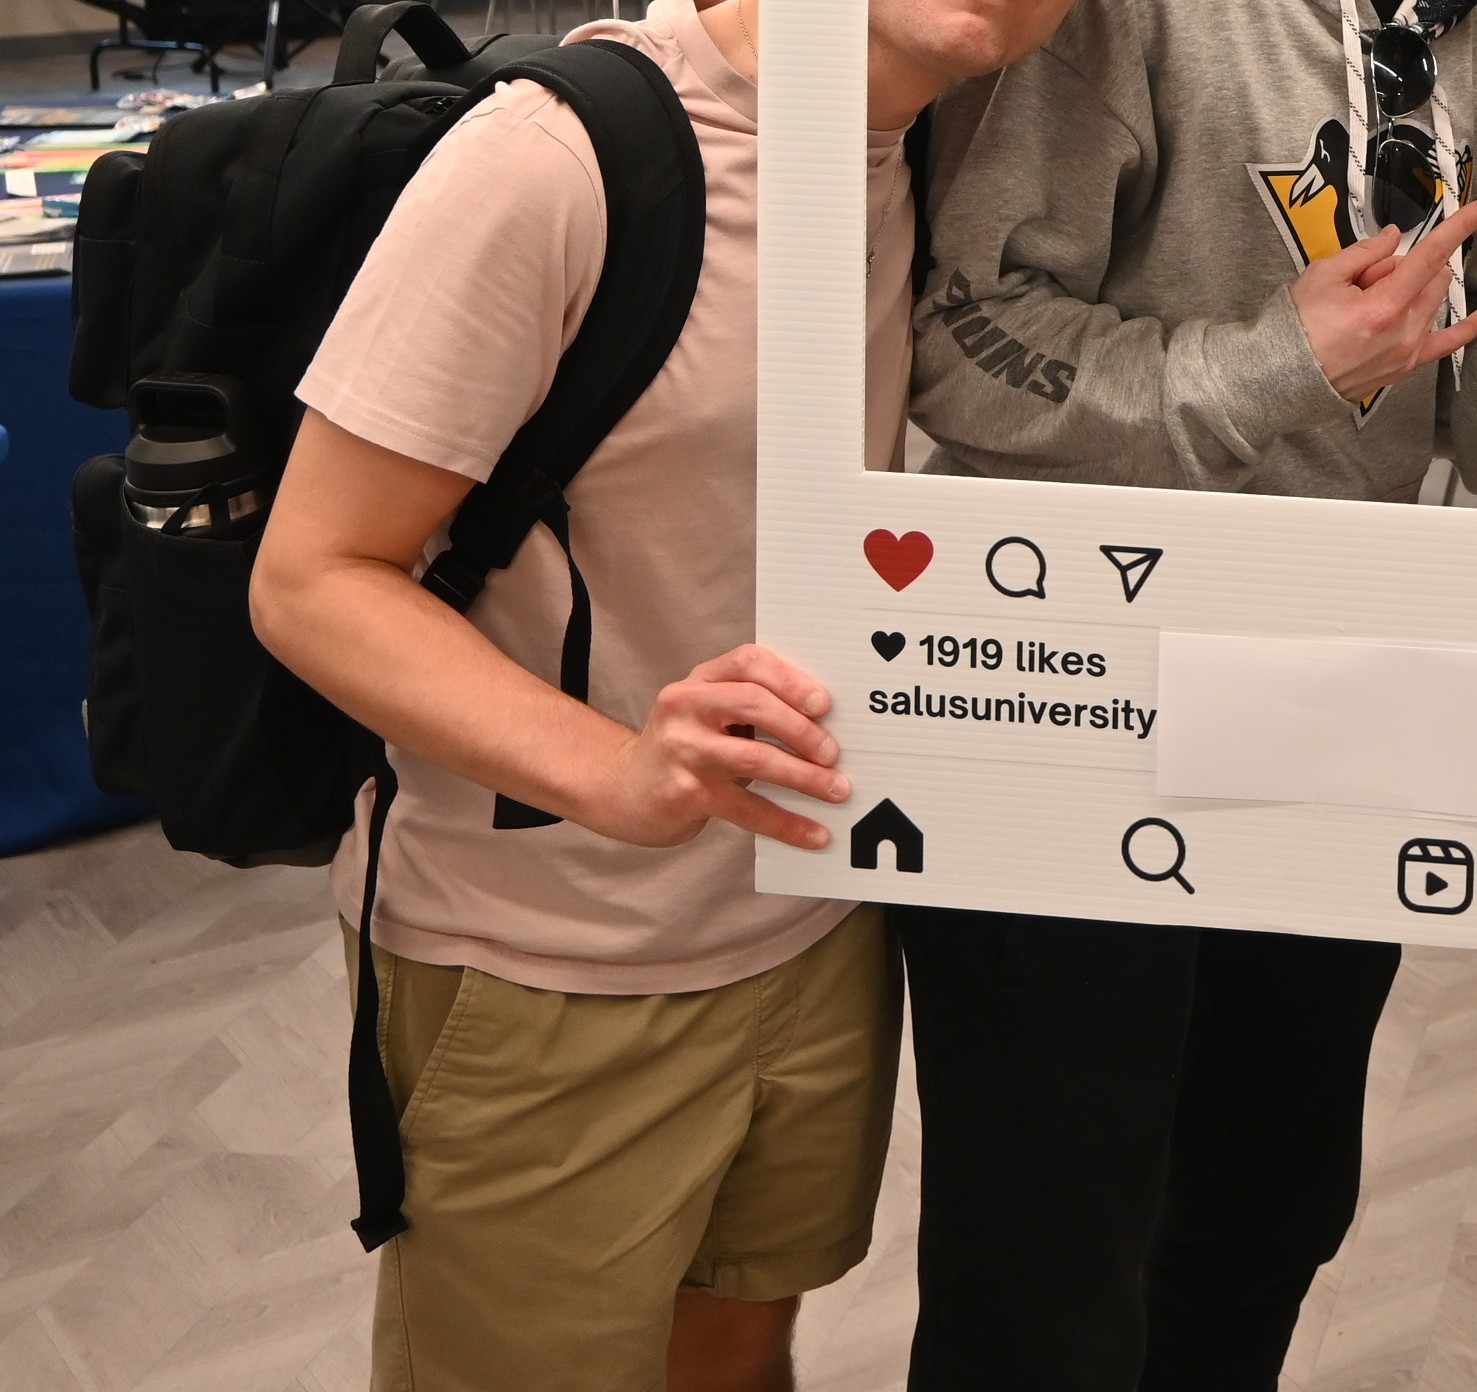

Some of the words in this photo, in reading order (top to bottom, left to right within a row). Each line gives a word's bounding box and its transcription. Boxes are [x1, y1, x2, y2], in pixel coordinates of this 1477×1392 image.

[919, 634, 1003, 671] 1919
[1016, 640, 1107, 678] likes
[868, 685, 1157, 740] salusuniversity
